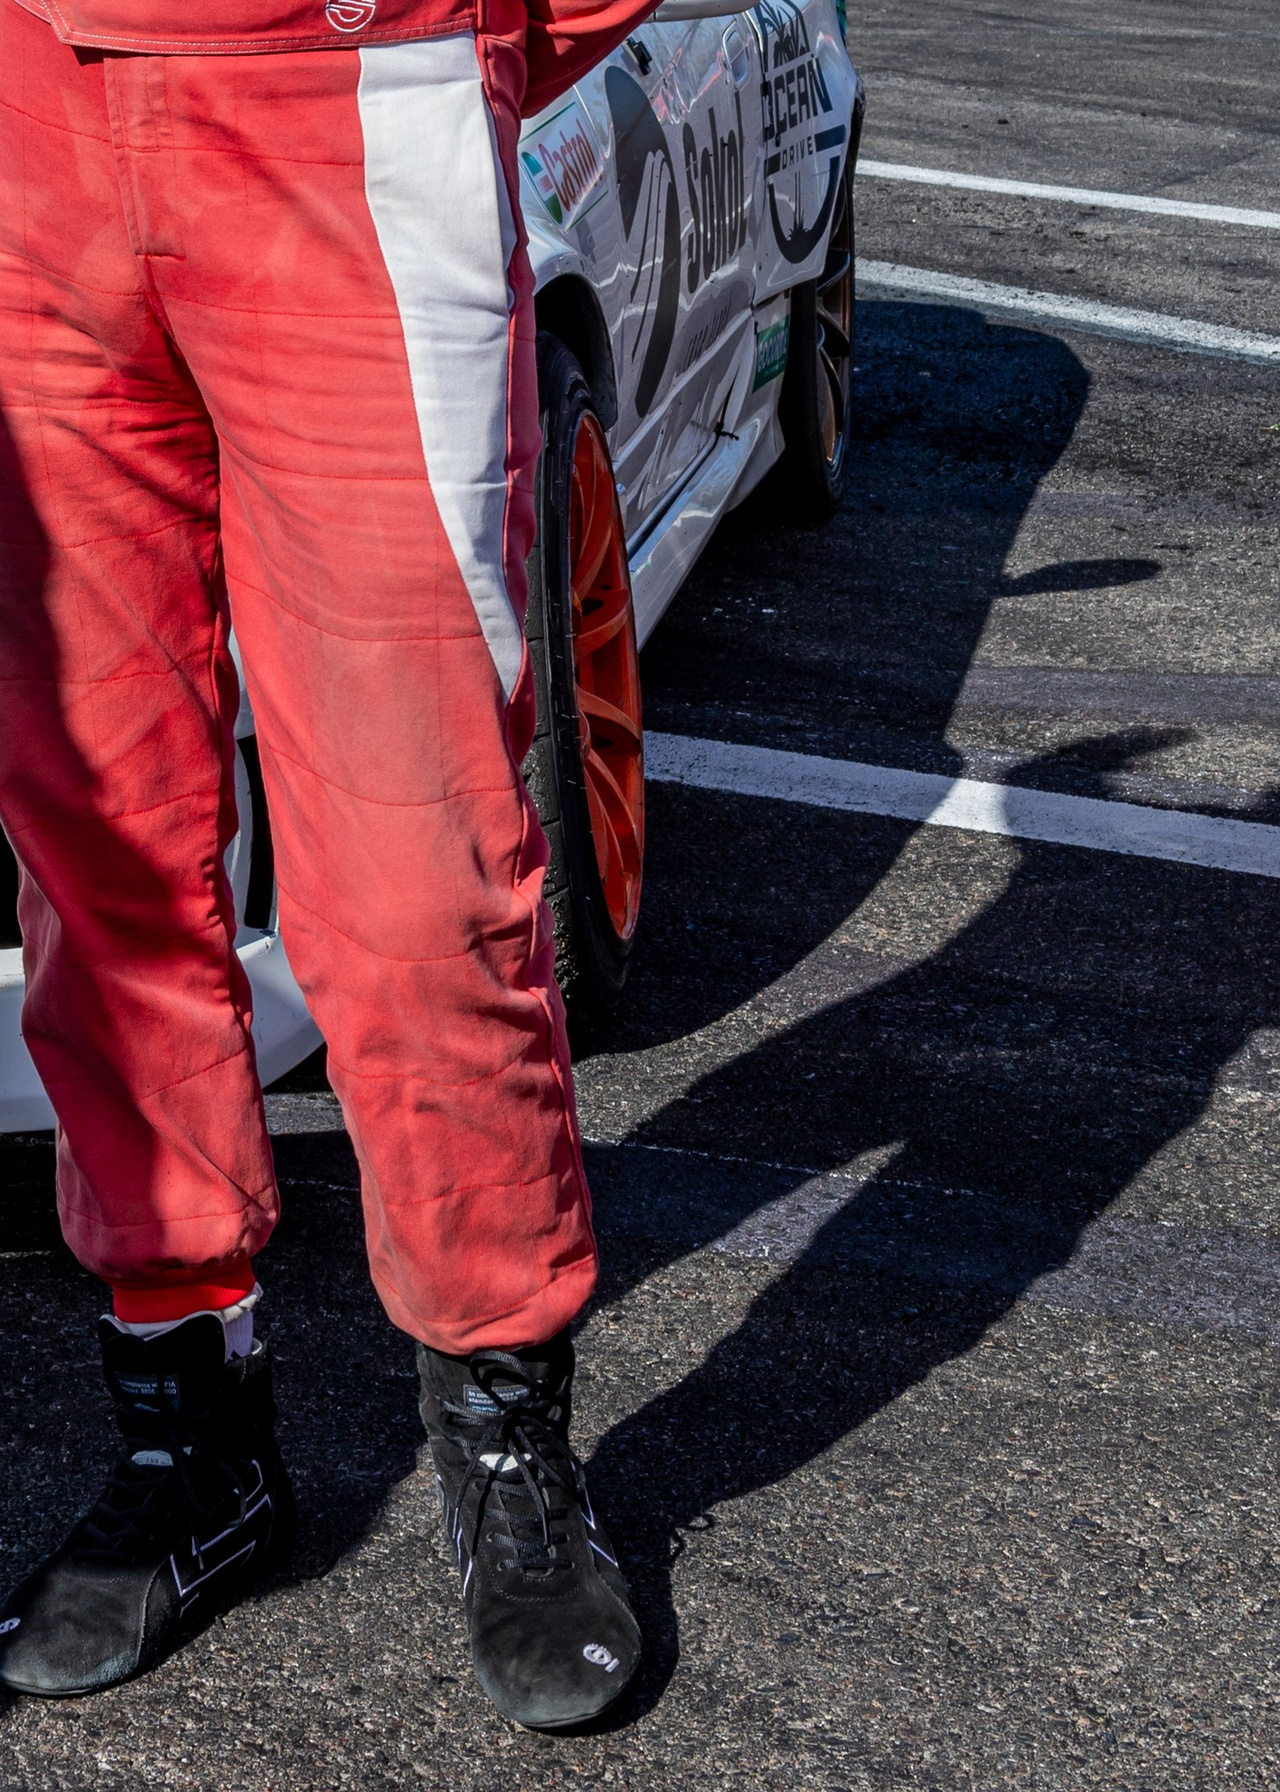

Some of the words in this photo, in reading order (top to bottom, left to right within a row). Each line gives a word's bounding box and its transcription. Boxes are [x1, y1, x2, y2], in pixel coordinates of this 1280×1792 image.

[760, 57, 834, 143] OCEAN
[538, 118, 603, 212] Castrol
[781, 135, 814, 171] DRIVE
